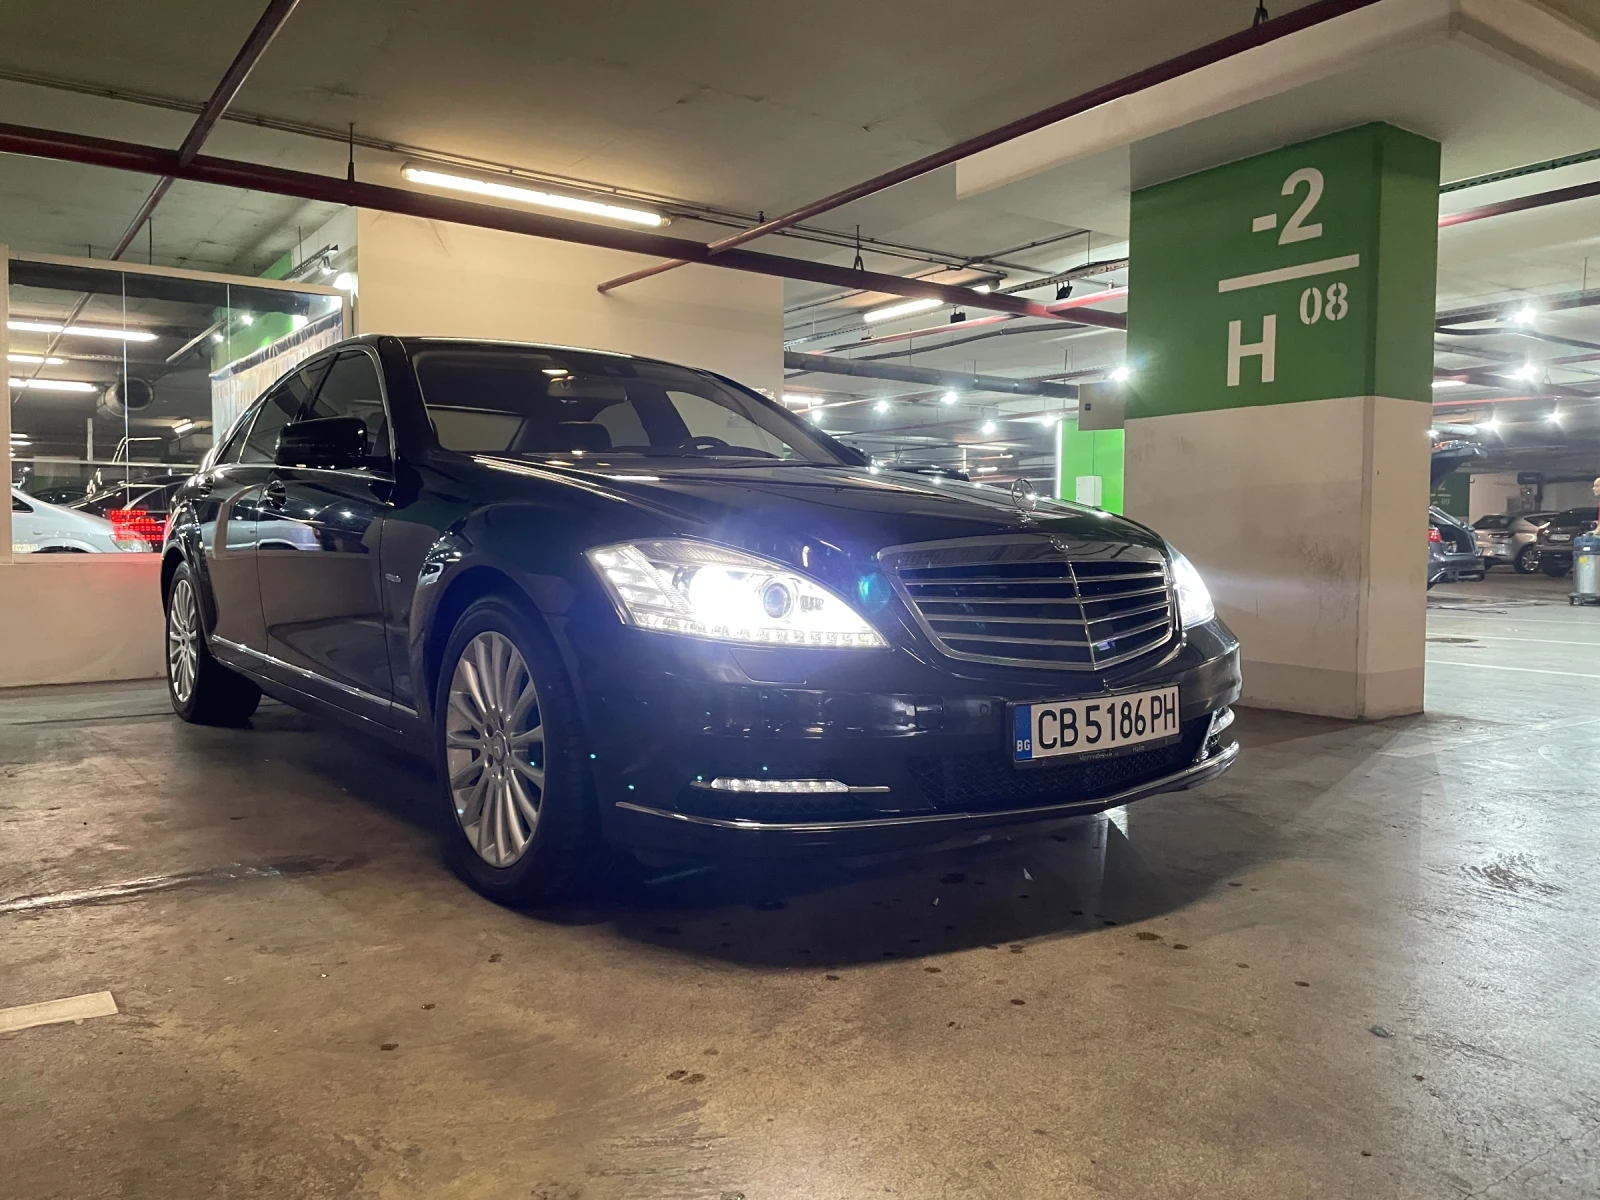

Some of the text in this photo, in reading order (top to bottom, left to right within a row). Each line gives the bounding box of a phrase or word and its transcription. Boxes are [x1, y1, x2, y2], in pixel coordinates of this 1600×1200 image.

[1252, 167, 1325, 246] -2
[1300, 282, 1349, 325] 08
[1227, 314, 1277, 387] H
[1016, 739, 1031, 752] BG
